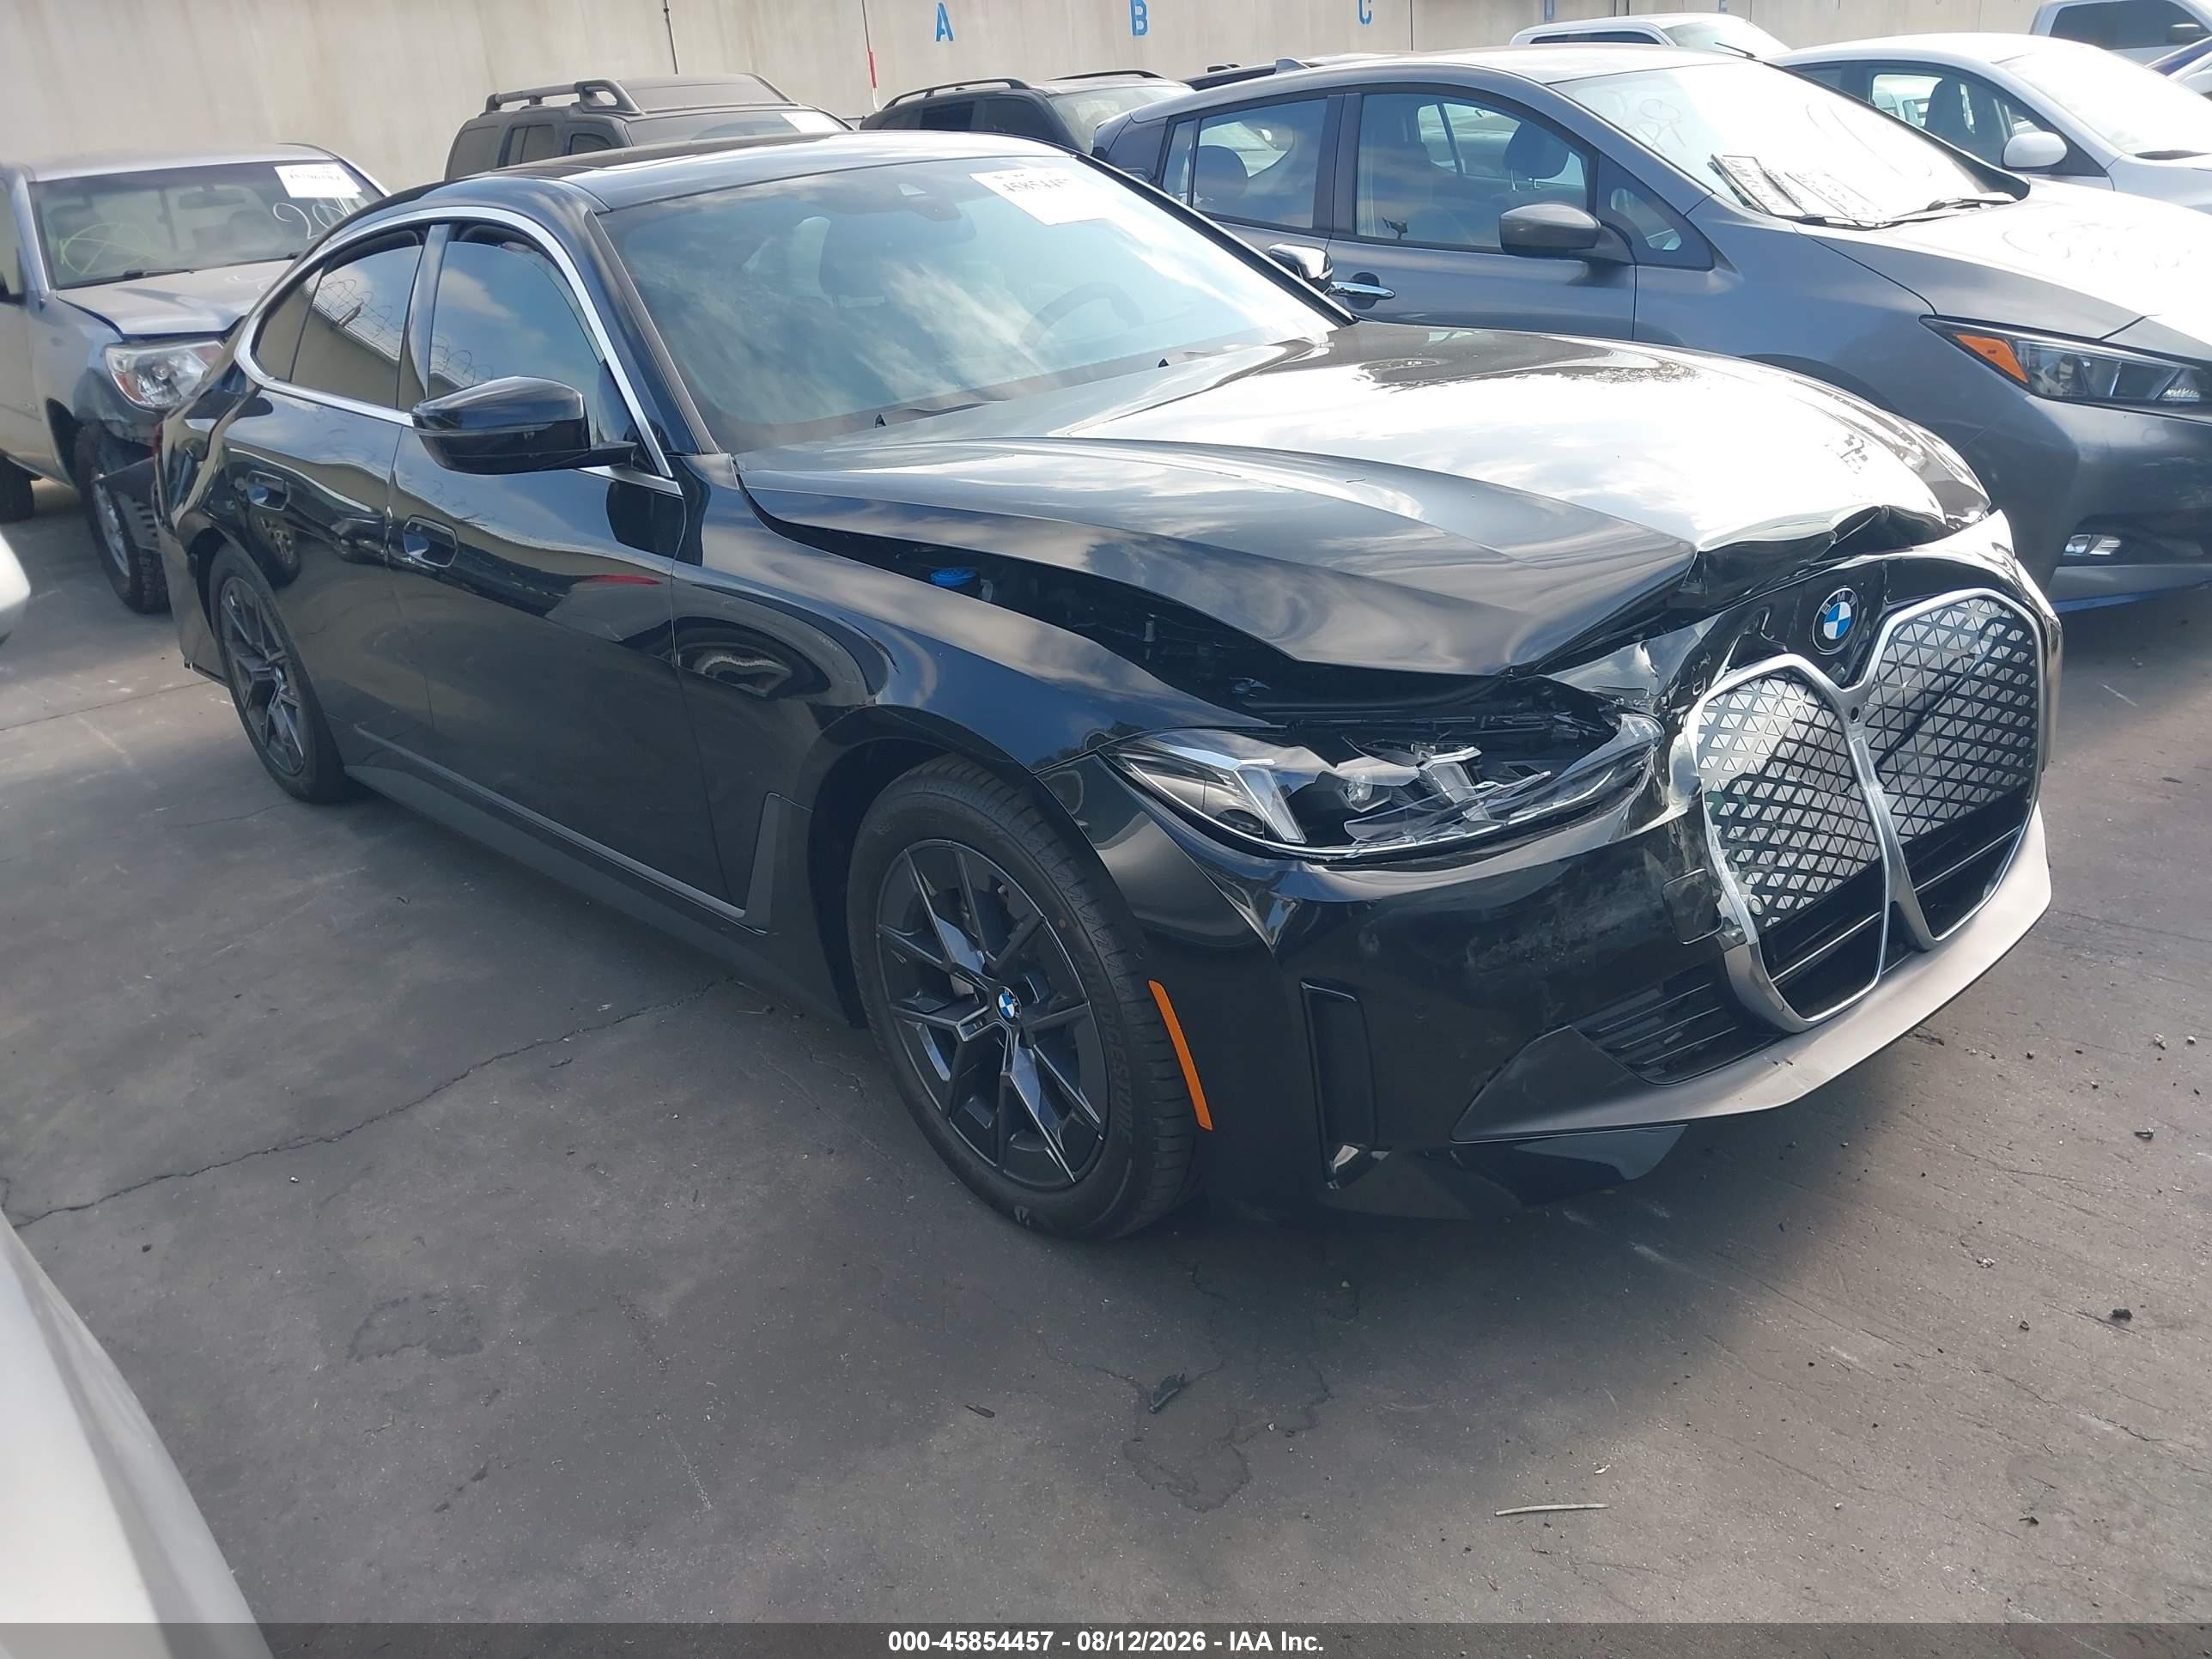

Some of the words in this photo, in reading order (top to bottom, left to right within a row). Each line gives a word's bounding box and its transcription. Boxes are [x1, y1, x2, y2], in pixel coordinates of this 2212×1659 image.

[934, 2, 955, 42] A
[1129, 0, 1149, 36] B
[1358, 0, 1373, 25] C
[1820, 590, 1857, 616] BMW
